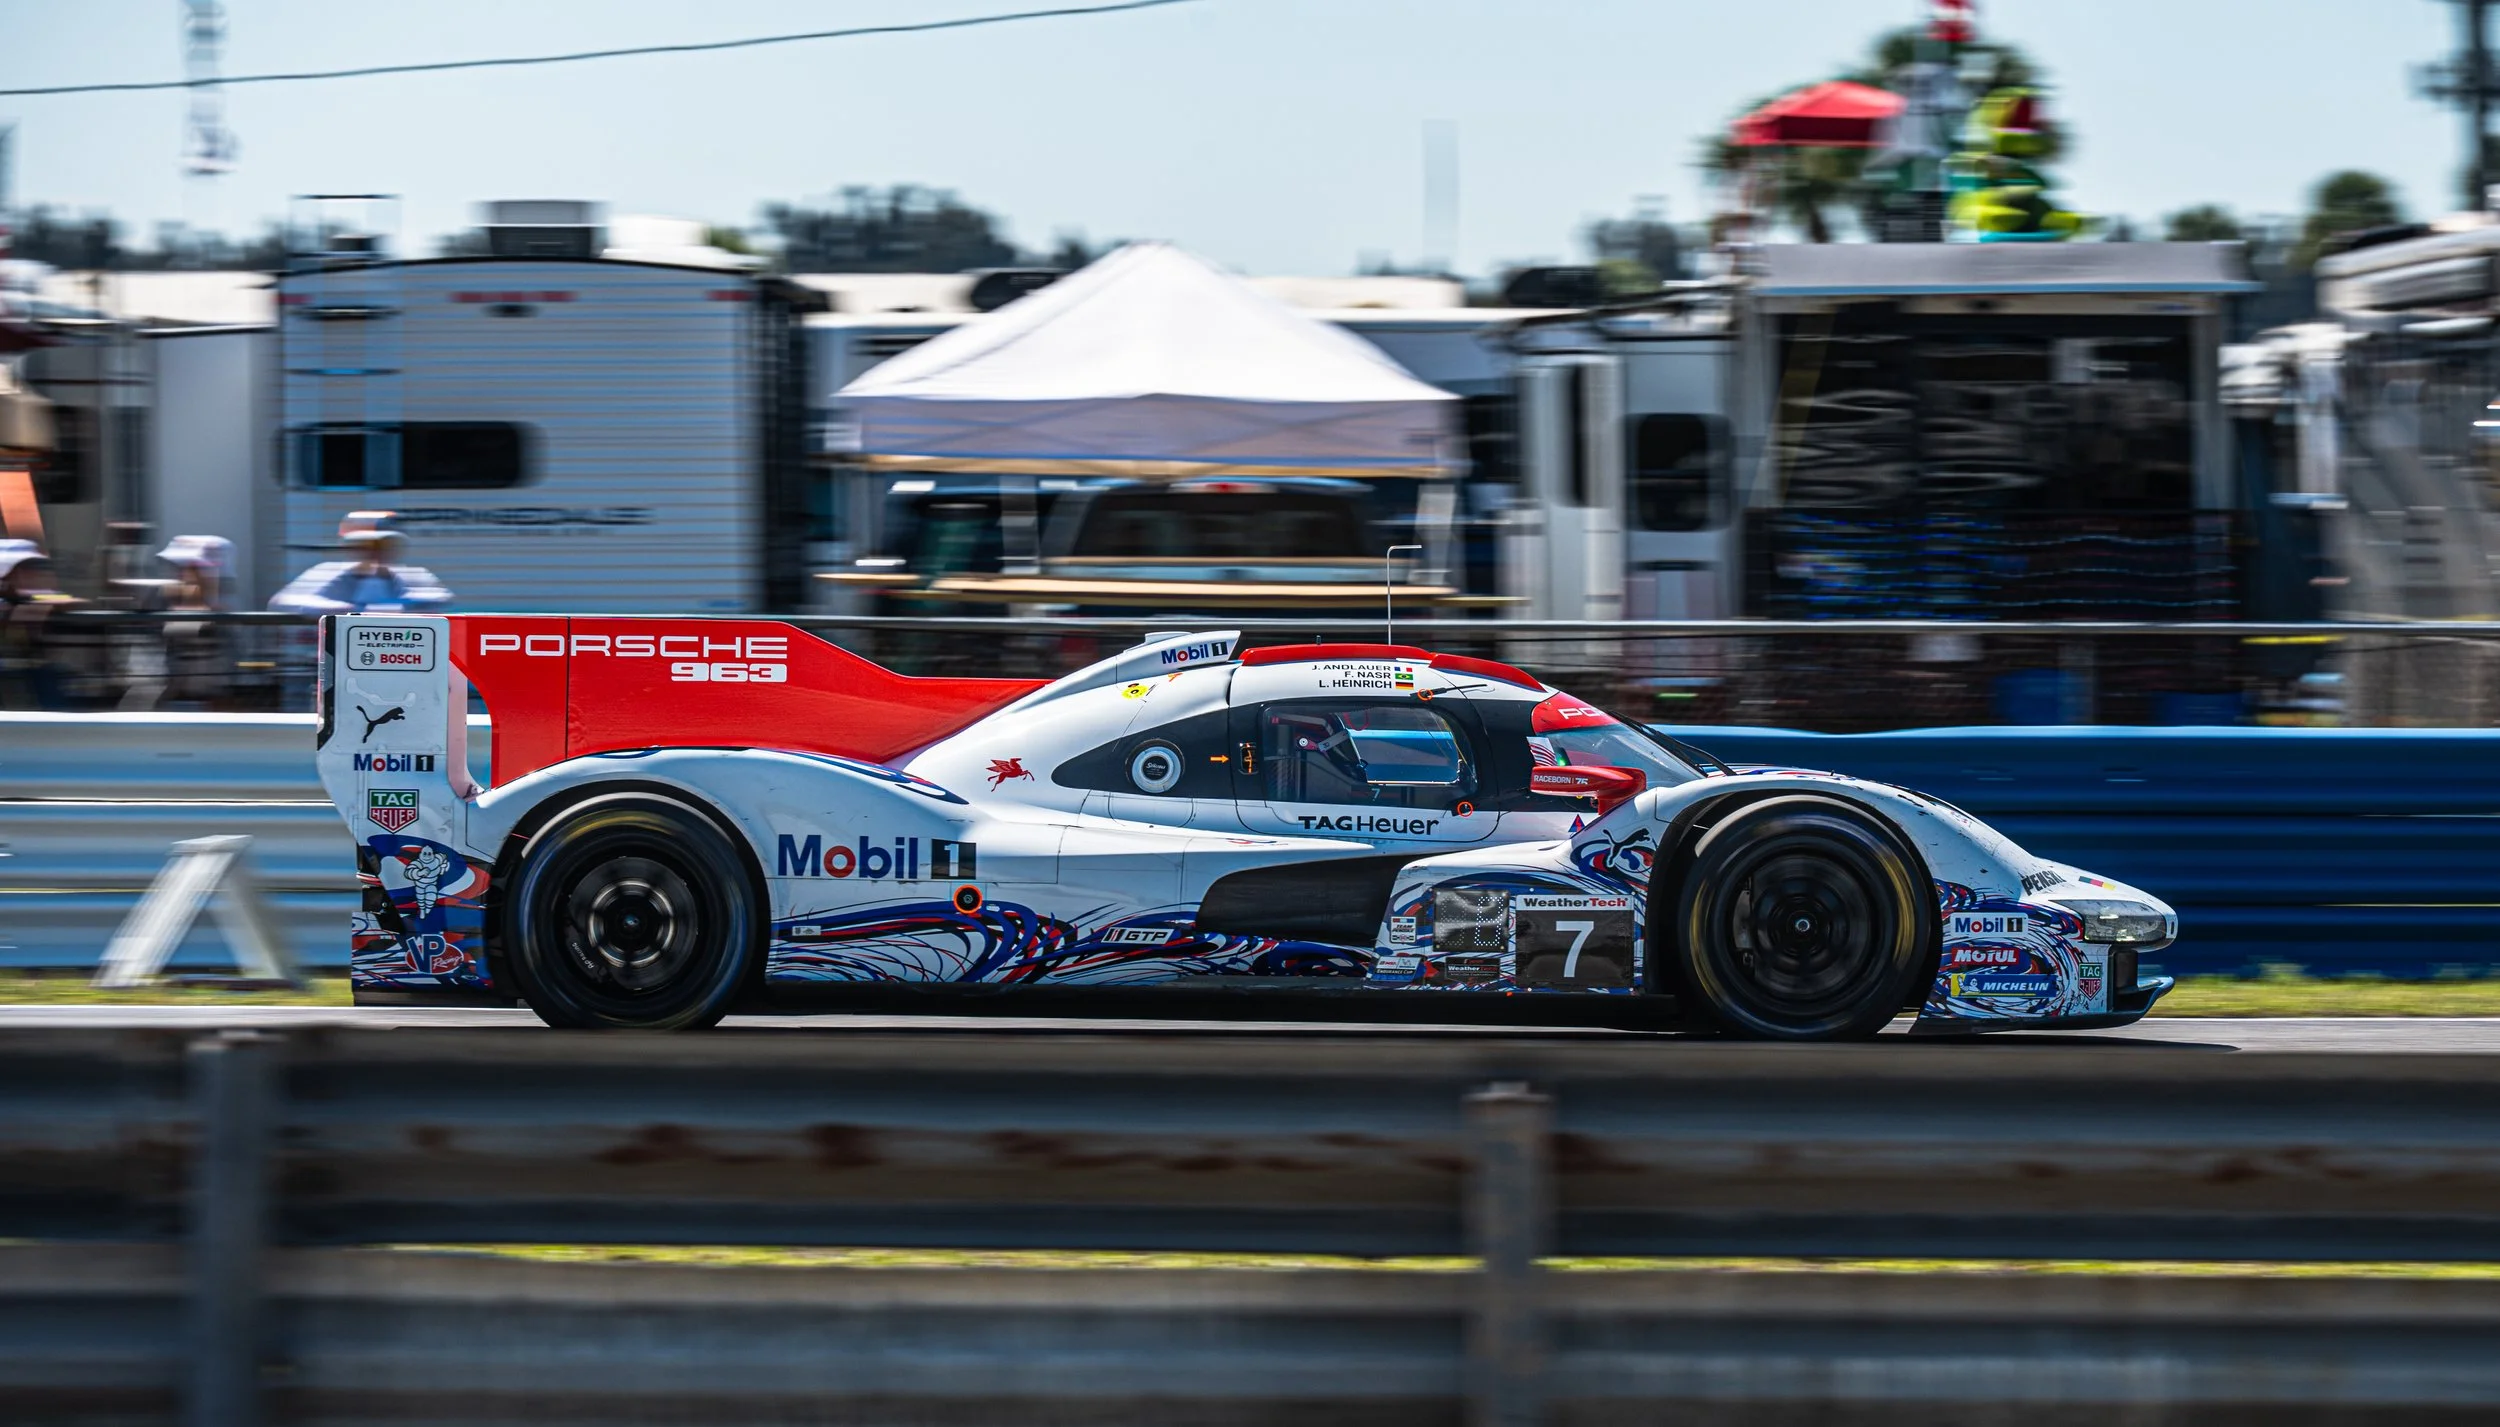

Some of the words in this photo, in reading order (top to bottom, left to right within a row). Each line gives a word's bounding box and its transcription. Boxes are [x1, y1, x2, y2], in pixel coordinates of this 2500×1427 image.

[359, 630, 423, 642] HYBRID
[480, 634, 788, 659] PORSCHE
[380, 653, 422, 665] BOSCH
[1161, 643, 1210, 664] Mobil
[671, 662, 787, 682] 963
[1357, 671, 1392, 679] NASR
[1318, 679, 1330, 688] L.
[1332, 679, 1393, 689] HEINRICH
[353, 753, 411, 772] Mobil
[1533, 774, 1572, 784] RACEBORN
[373, 793, 414, 806] TAG
[371, 809, 416, 829] HEUER
[778, 834, 919, 879] Mobil
[1955, 917, 2003, 933] Mobil
[1125, 931, 1168, 941] GTP
[406, 934, 446, 974] VP
[1556, 920, 1594, 977] 7
[1954, 949, 2017, 962] MOTUL
[2081, 966, 2100, 977] TAG
[1982, 982, 2050, 991] MICHELIN
